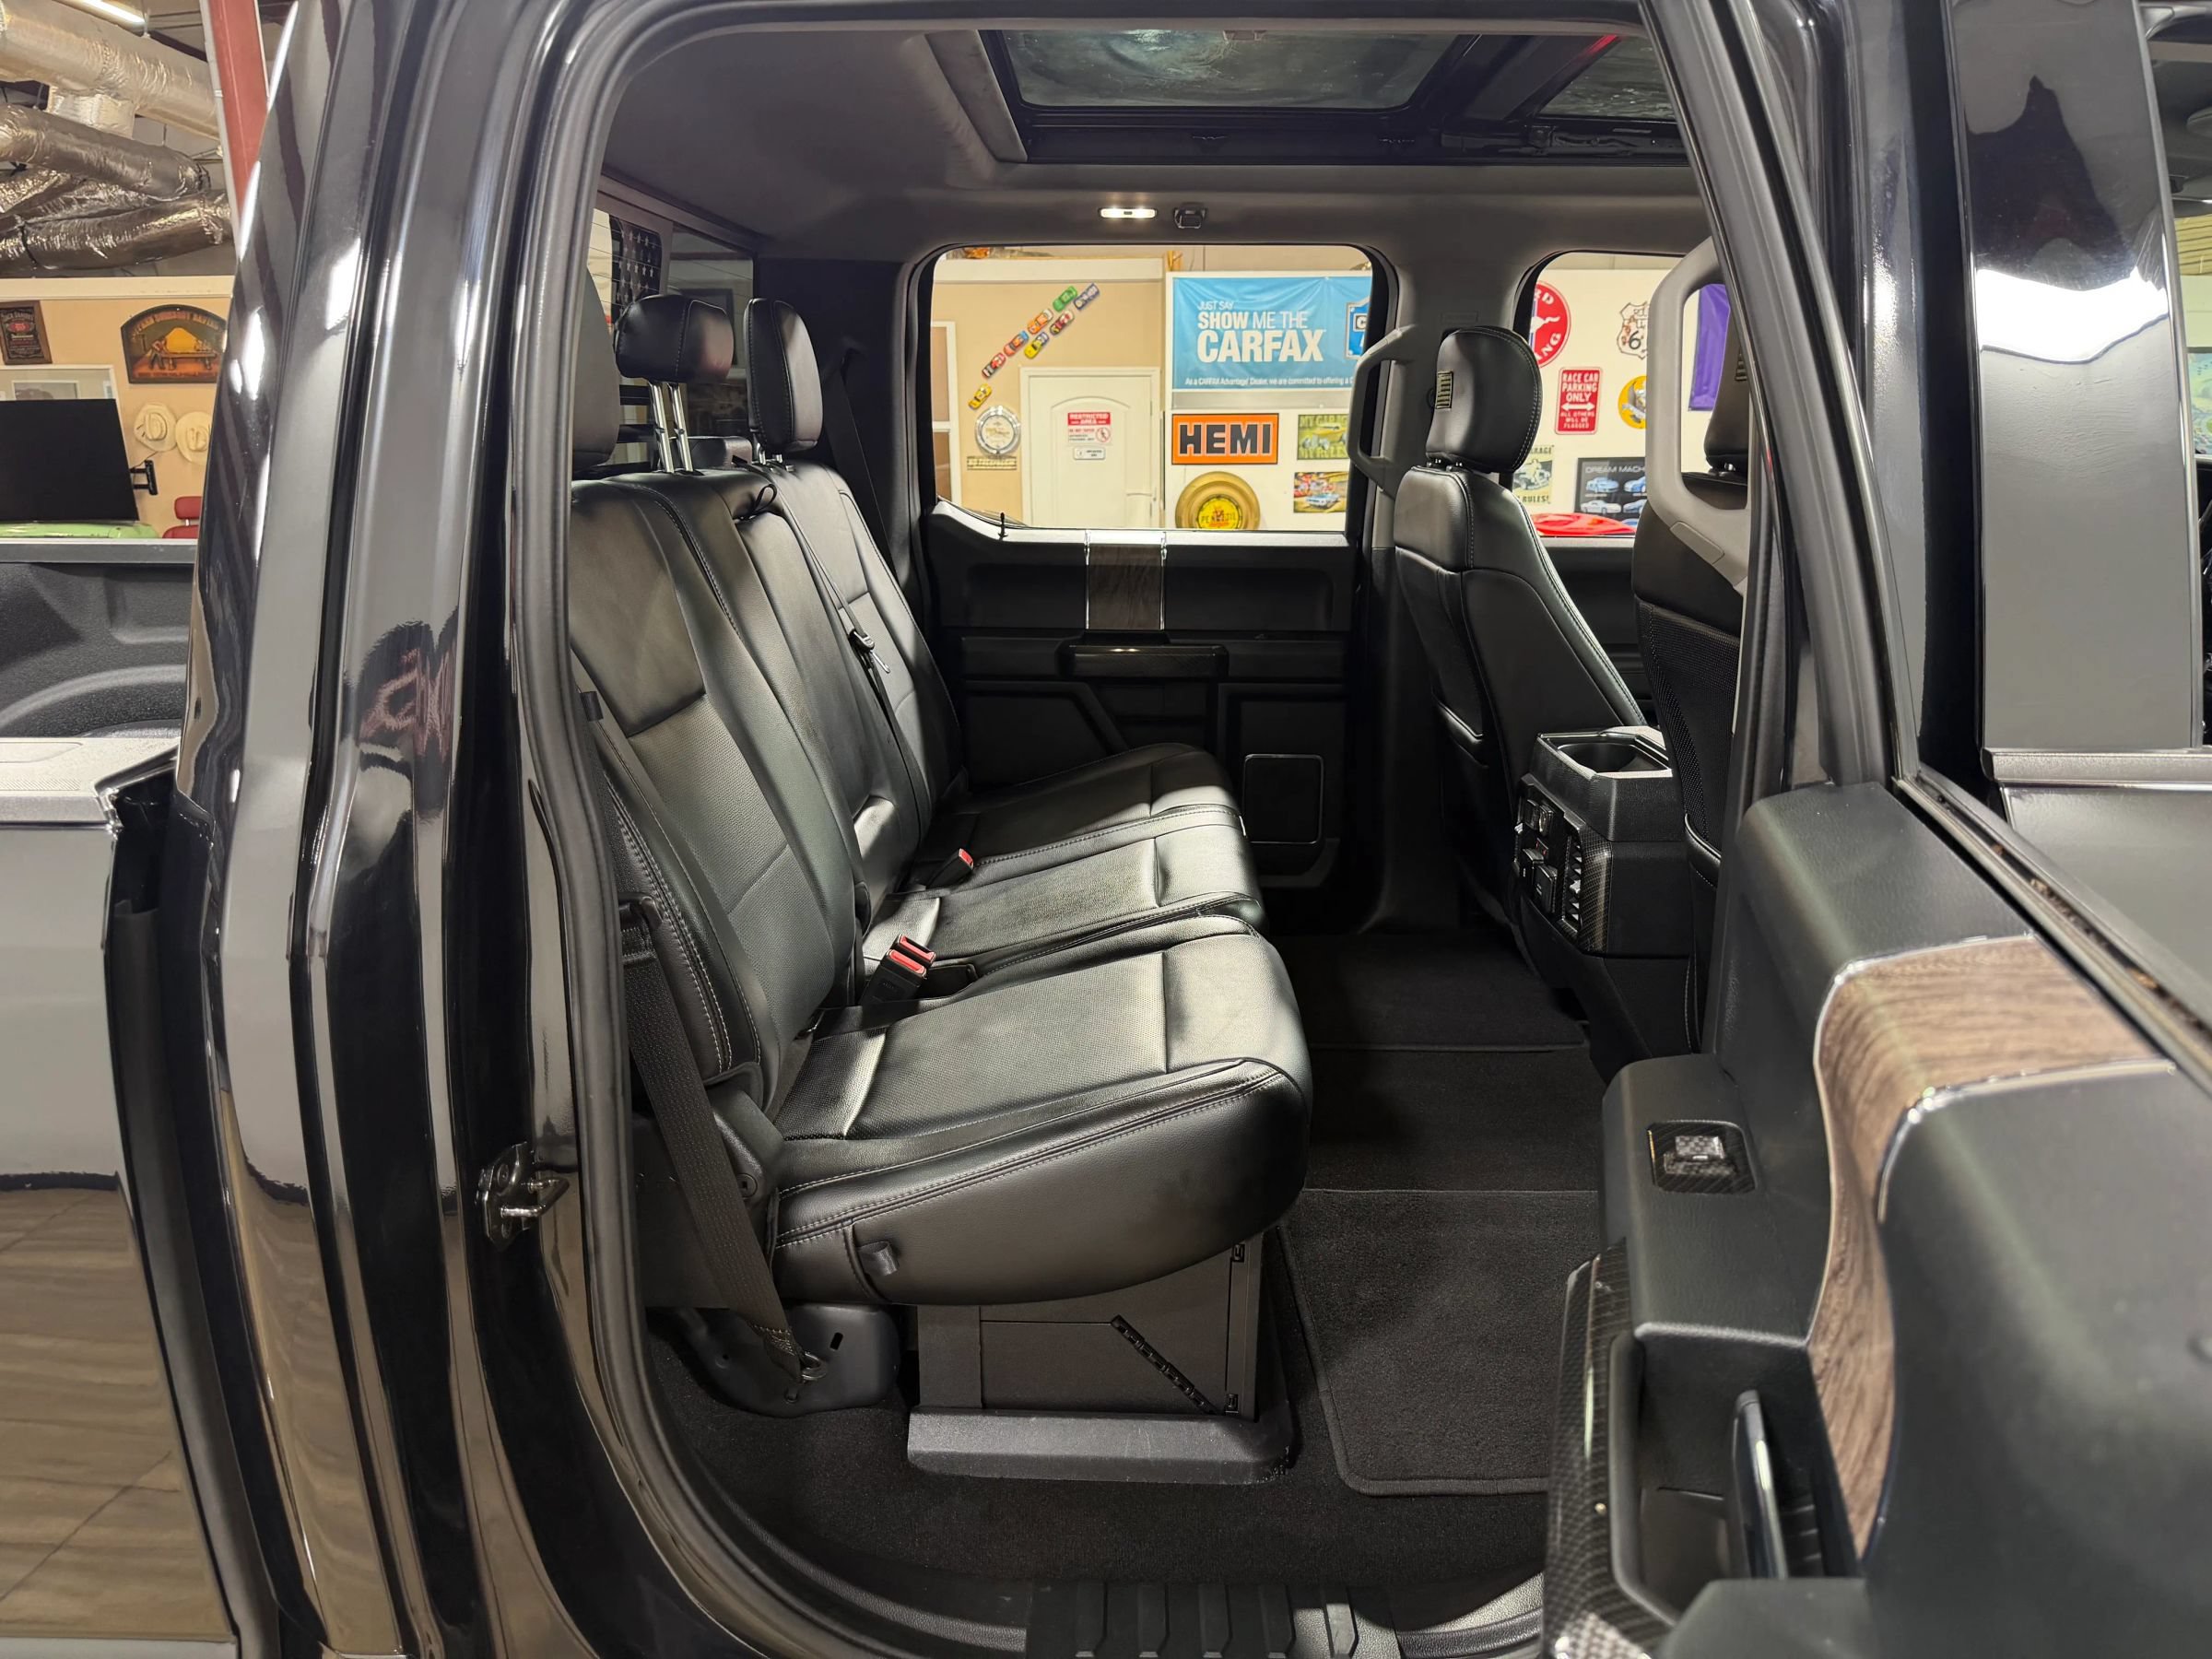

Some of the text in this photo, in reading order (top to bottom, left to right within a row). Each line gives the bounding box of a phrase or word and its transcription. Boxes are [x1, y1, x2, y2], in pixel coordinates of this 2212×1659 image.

[1535, 288, 1555, 305] RD
[1198, 300, 1234, 311] JUST SAY
[1198, 311, 1309, 330] SHOW ME THE
[1197, 330, 1324, 363] CARFAX
[1563, 372, 1599, 383] RACE CAR
[1562, 382, 1597, 393] PARKING
[1566, 392, 1592, 402] ONLY
[1299, 416, 1313, 428] MY
[1179, 423, 1272, 455] HEMI
